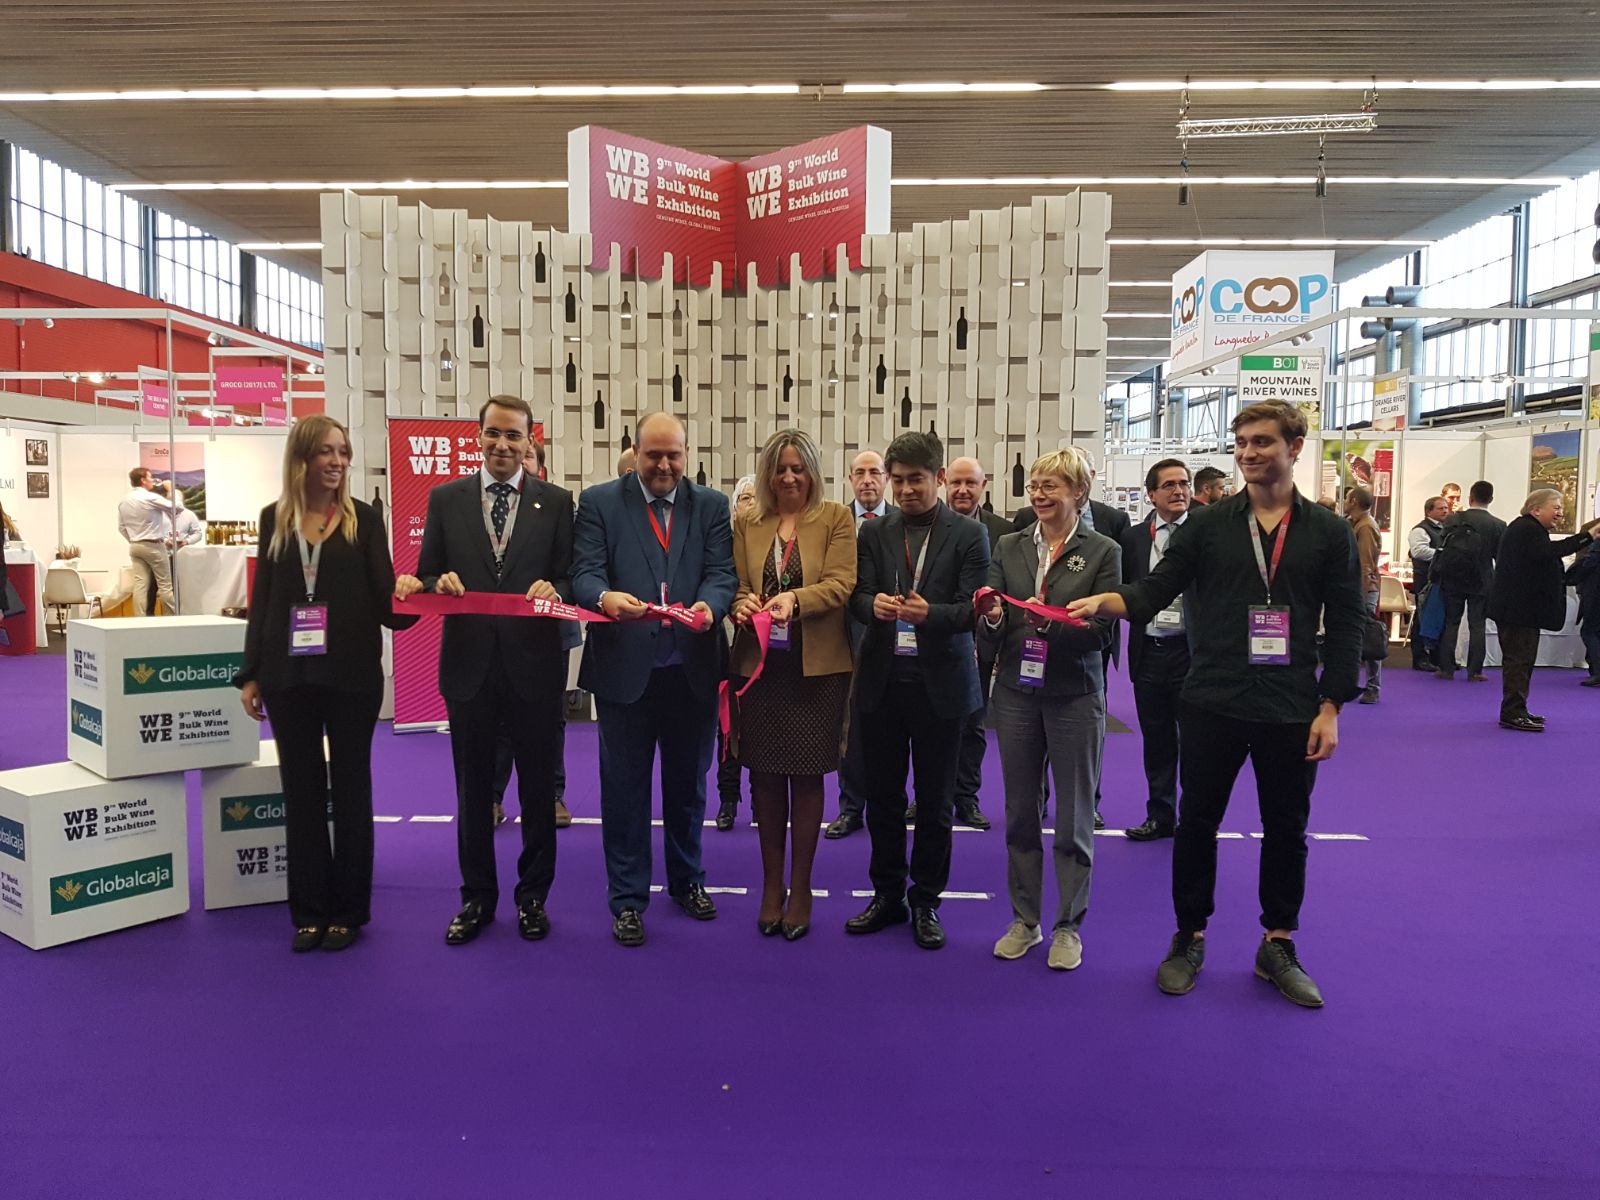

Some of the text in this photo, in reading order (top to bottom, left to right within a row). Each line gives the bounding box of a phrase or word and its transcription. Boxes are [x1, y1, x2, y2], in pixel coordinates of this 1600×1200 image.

[605, 144, 650, 178] WB
[804, 148, 839, 169] World
[675, 162, 711, 182] World
[747, 165, 783, 195] WB
[787, 168, 848, 192] Bulk Wine
[605, 171, 649, 205] WE
[656, 176, 719, 202] Bulk Wine
[656, 195, 721, 220] Exhibition
[747, 190, 781, 220] WE
[787, 187, 849, 211] Exhibition
[1173, 276, 1204, 330] COOP
[1210, 274, 1329, 314] COOP
[1242, 314, 1310, 322] FRANCE
[1250, 376, 1311, 385] MOUNTAIN
[1243, 387, 1317, 396] RIVER WINES
[1375, 394, 1406, 406] ORANGE RIVER
[408, 436, 452, 455] WB
[409, 456, 451, 475] WE
[158, 664, 241, 683] Globalcaja
[139, 713, 173, 729] WB
[193, 709, 221, 718] World
[179, 719, 229, 730] Bulk Wine
[139, 728, 173, 744] WE
[179, 729, 230, 741] Exhibition
[118, 798, 147, 810] World
[63, 807, 98, 826] WB
[104, 808, 155, 824] Bulk Wine
[64, 823, 98, 841] WE
[105, 819, 157, 835] Exhibition
[236, 847, 269, 861] WB
[237, 861, 268, 876] WE
[86, 867, 170, 896] Globalcaja
